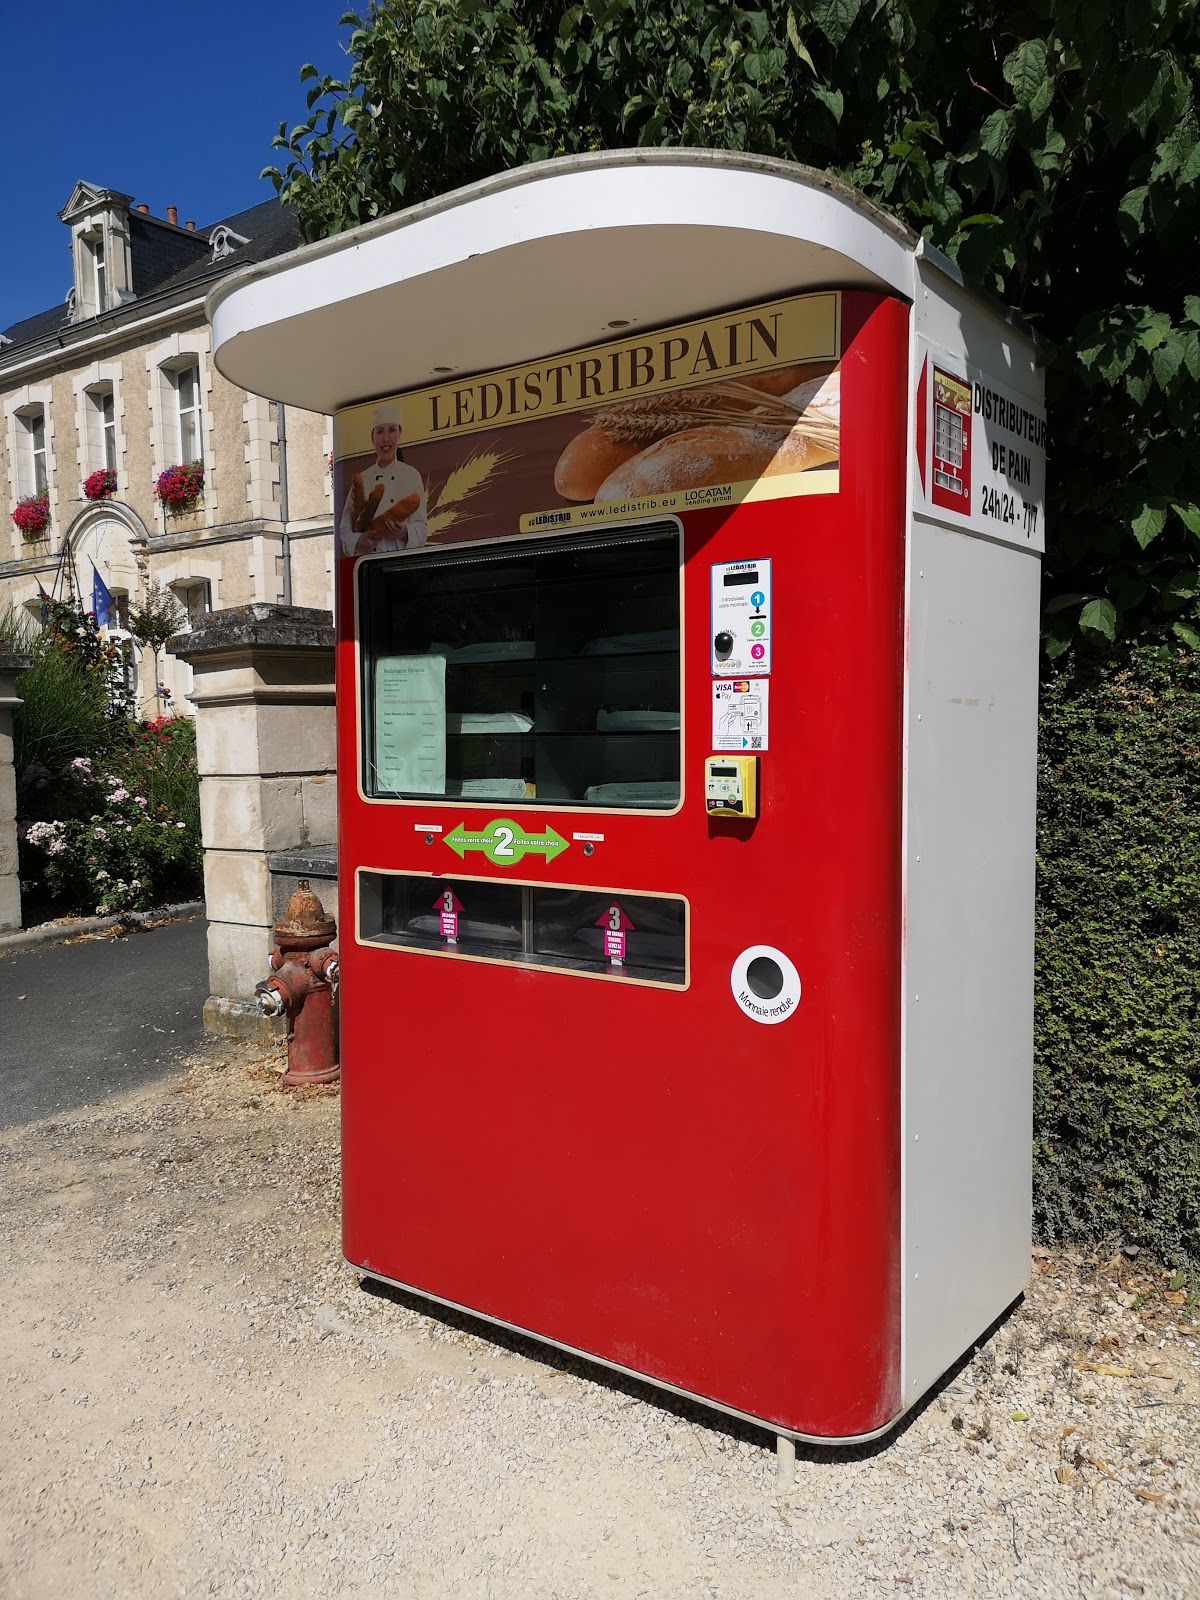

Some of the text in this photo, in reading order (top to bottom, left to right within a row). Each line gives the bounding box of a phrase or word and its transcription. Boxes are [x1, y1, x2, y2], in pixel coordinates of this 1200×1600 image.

[429, 313, 783, 432] LEDISTRIBPAIN
[974, 382, 1047, 448] DISTRIBUTEUR
[992, 441, 1031, 486] DE PAIN
[535, 486, 731, 525] LEDISTRIB www.ledistrib.eu LOCATAM
[685, 495, 731, 506] vending group
[982, 485, 1014, 525] 24h/24
[722, 692, 731, 701] Pay
[493, 826, 514, 856] 2
[546, 839, 559, 847] choix
[443, 891, 454, 913] 3
[609, 906, 621, 930] 3
[738, 991, 794, 1018] Monnaie rendue
